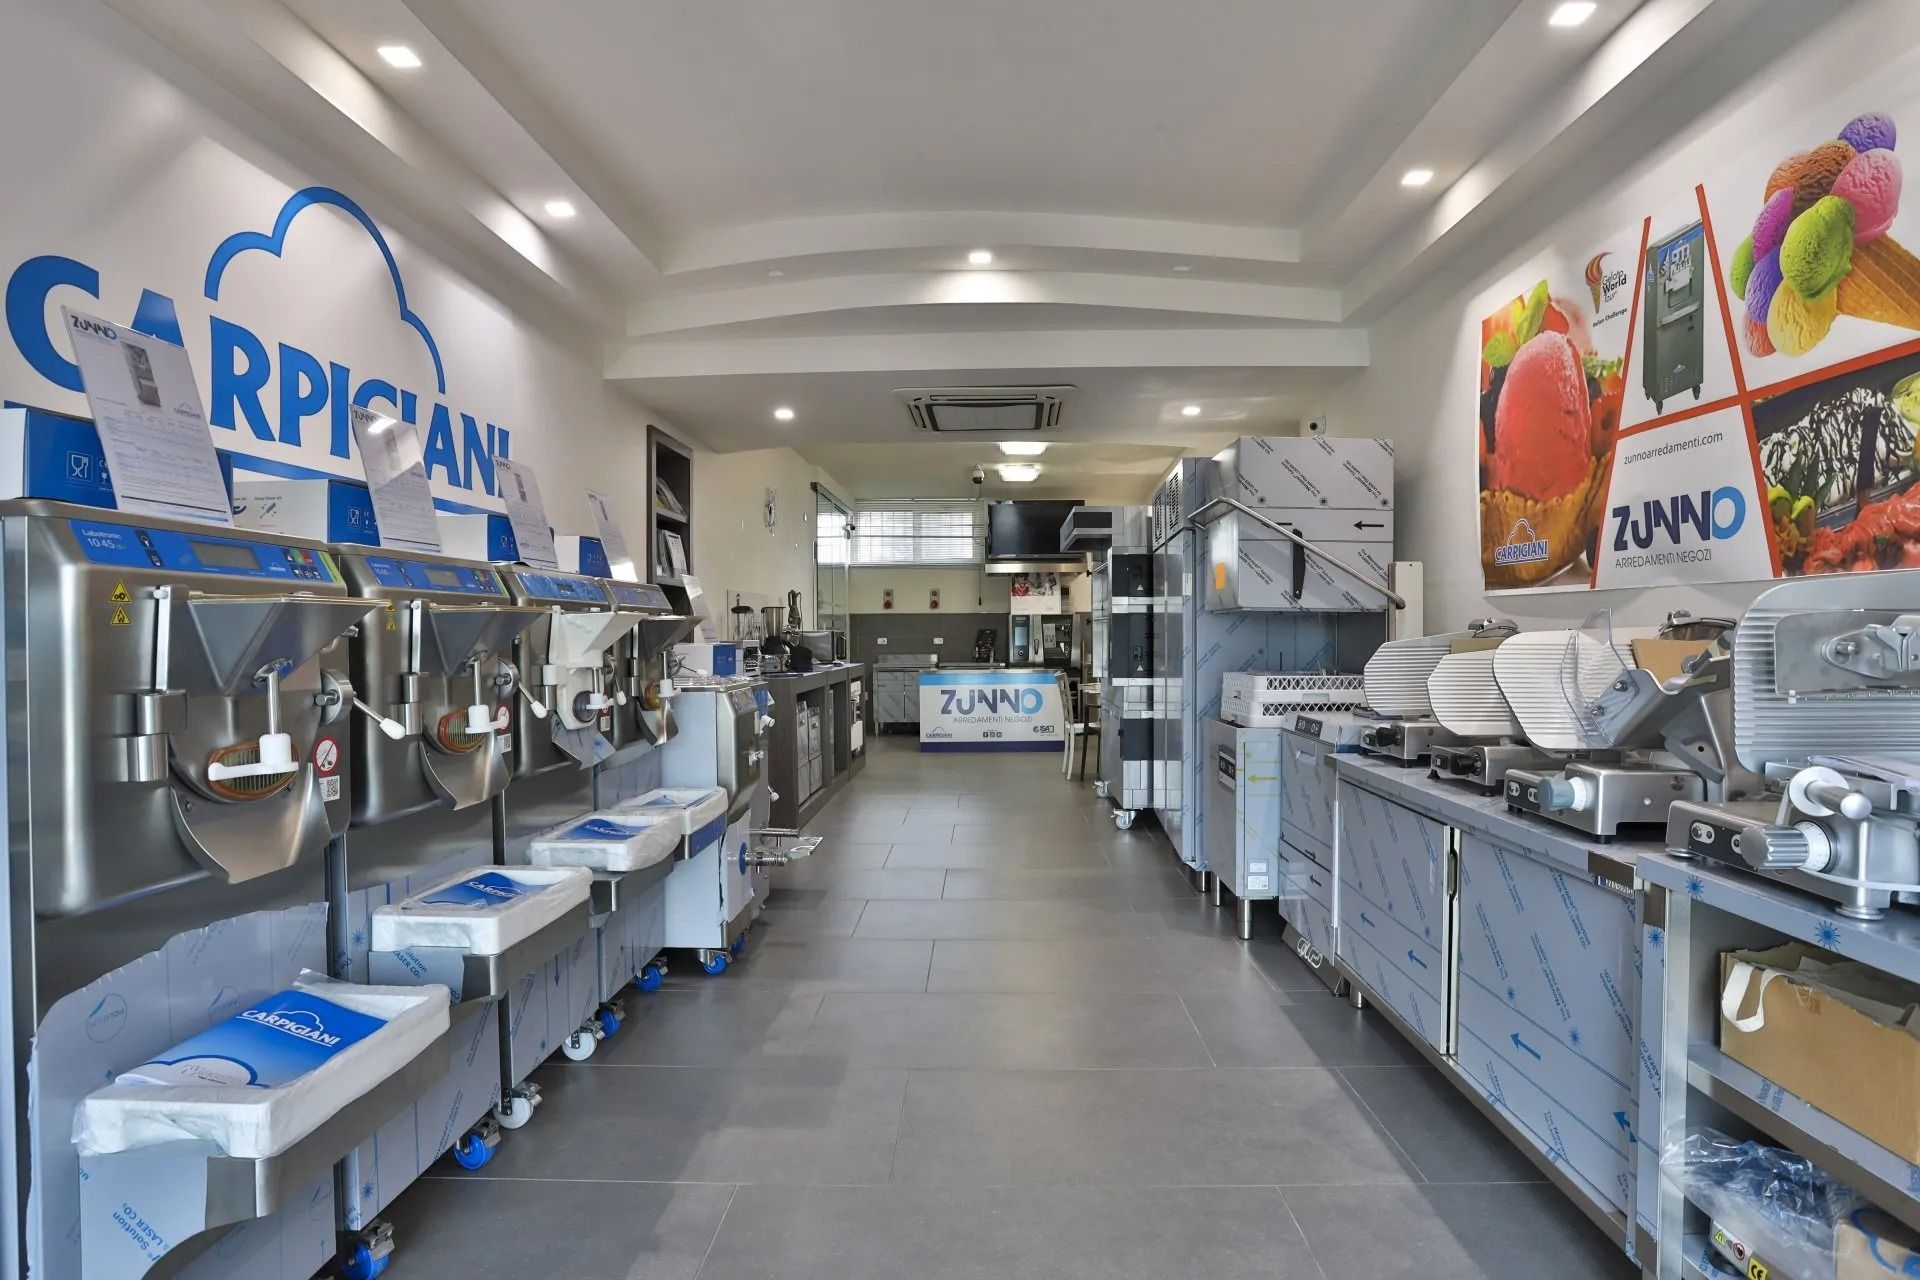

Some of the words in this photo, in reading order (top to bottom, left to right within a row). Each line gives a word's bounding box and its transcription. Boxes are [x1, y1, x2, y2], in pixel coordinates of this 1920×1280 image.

[1602, 270, 1624, 285] Gelato
[1602, 274, 1627, 295] World
[1605, 308, 1627, 320] Challenge
[71, 315, 117, 340] ZUNNO
[1624, 432, 1723, 465] zunnoarredamenti.com
[1612, 486, 1746, 551] ZUNNO
[1495, 540, 1548, 560] CARPIGIANI
[1615, 552, 1677, 568] ARREDAMENTI
[1677, 549, 1711, 563] NEGOZI
[941, 688, 1043, 715] ZUNNO
[953, 716, 1002, 724] ARREDAMENTI
[405, 951, 428, 973] olution
[242, 1010, 342, 1045] CARPIGIANI
[113, 1211, 150, 1250] Solution
[136, 1218, 163, 1246] LASER
